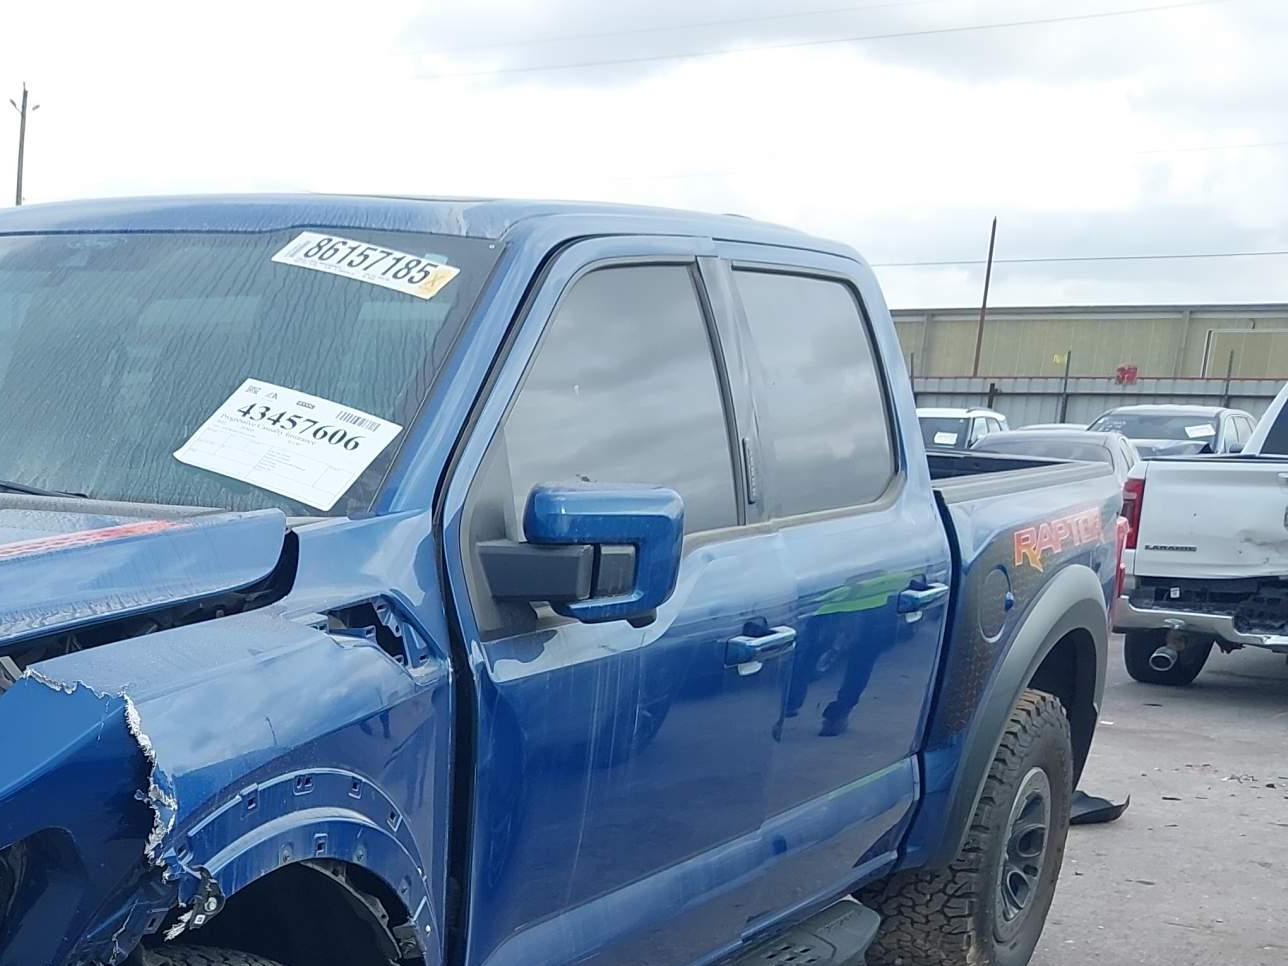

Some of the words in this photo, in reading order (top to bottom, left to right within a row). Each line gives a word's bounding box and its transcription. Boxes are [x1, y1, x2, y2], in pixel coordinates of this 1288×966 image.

[303, 237, 440, 285] 86157185
[237, 402, 367, 451] 43457606
[1014, 506, 1105, 573] RAPTOR
